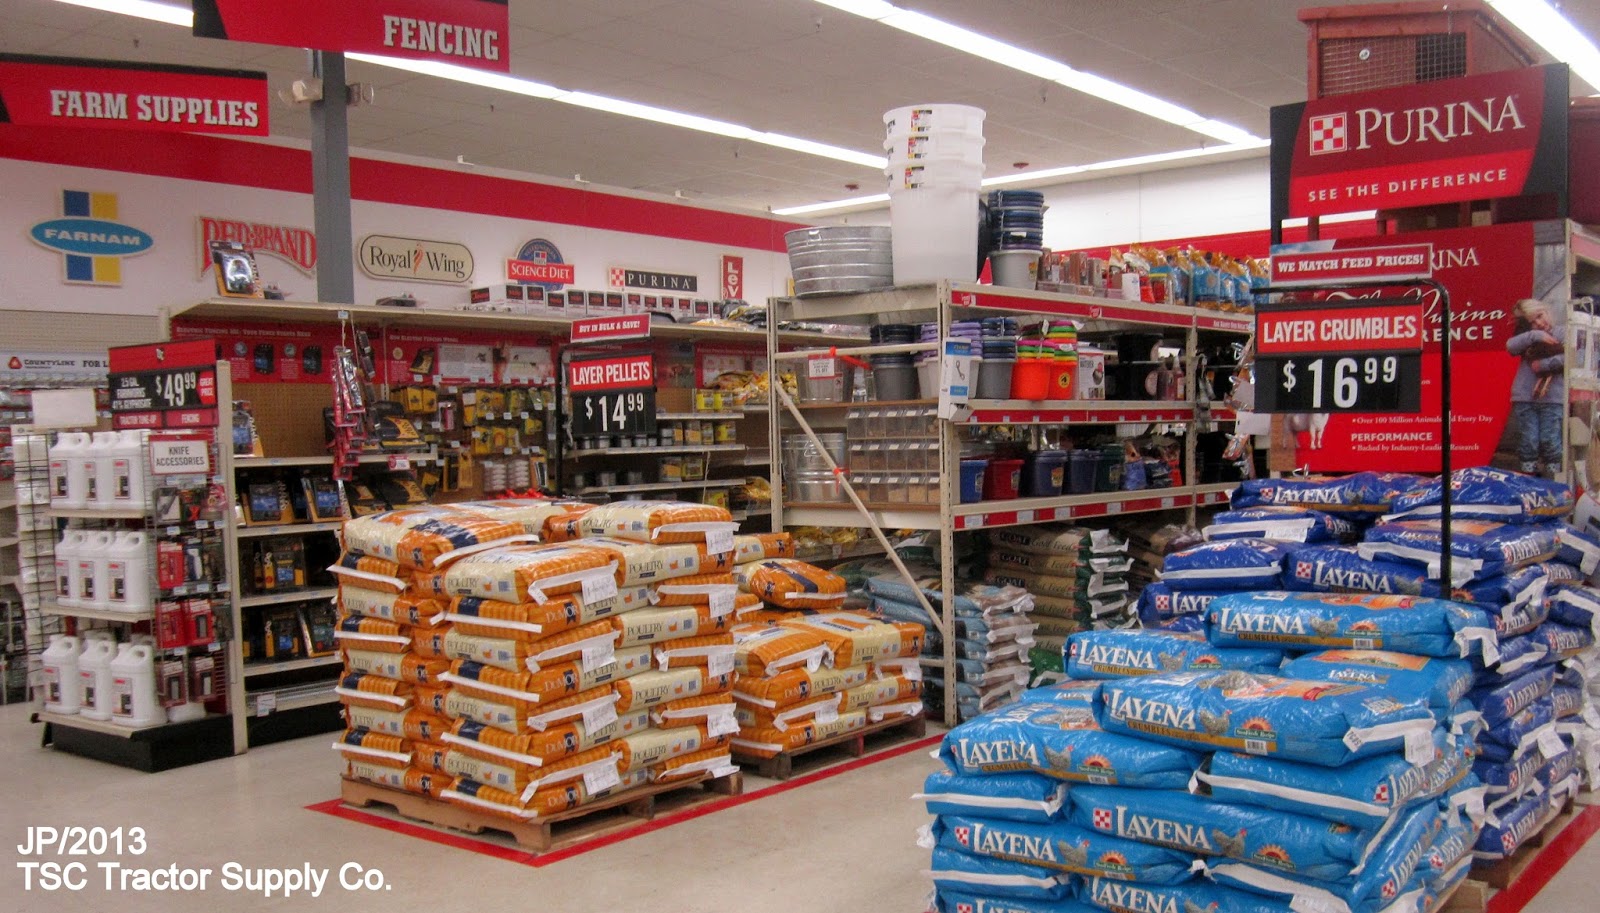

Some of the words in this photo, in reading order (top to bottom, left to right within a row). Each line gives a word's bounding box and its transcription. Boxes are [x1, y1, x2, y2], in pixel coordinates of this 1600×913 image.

[383, 15, 500, 61] FENCING
[50, 89, 128, 120] FARM
[137, 95, 259, 128] SUPPLIES
[1355, 95, 1525, 151] PURINA
[1308, 188, 1337, 202] SEE
[1346, 183, 1379, 198] THE
[1388, 168, 1507, 194] DIFFERENCE
[43, 228, 140, 246] FARNAM
[370, 246, 411, 273] Royal
[426, 252, 465, 278] Wing
[1278, 261, 1297, 273] WE
[1298, 258, 1338, 271] MATCH
[1341, 256, 1373, 269] FEED
[1375, 253, 1424, 267] PRICES!
[1432, 247, 1479, 270] INA
[511, 262, 547, 278] SCIENCE
[549, 266, 570, 279] DIET
[628, 273, 690, 289] PURINA
[578, 324, 591, 333] BUY
[599, 323, 616, 331] BULK
[622, 320, 641, 329] SAVE!
[1263, 320, 1315, 344] LAYER
[1320, 315, 1417, 342] CRUMBLES
[573, 365, 603, 385] LAYER
[606, 360, 650, 383] PELLETS
[1457, 415, 1476, 424] Every
[1478, 414, 1494, 424] Day
[1351, 432, 1433, 442] PERFORMANCE
[156, 456, 205, 467] ACCESSORIES
[168, 446, 190, 456] KNIFE
[1273, 485, 1343, 504] LAYENA
[628, 560, 664, 573] POULTRY
[1313, 560, 1391, 594] LAYENA
[1172, 591, 1217, 613] LAYE
[627, 622, 664, 636] POULTRY
[1220, 607, 1305, 635] LAYENA
[1078, 638, 1156, 669] LAYENA
[636, 684, 670, 700] POULTRY
[1110, 688, 1196, 730] LAYENA
[634, 745, 668, 761] POULTRY
[958, 738, 1041, 768] LAYENA
[1116, 806, 1212, 850] LAYENA
[973, 823, 1057, 862] LAYENA
[1091, 877, 1179, 913] LAYENA
